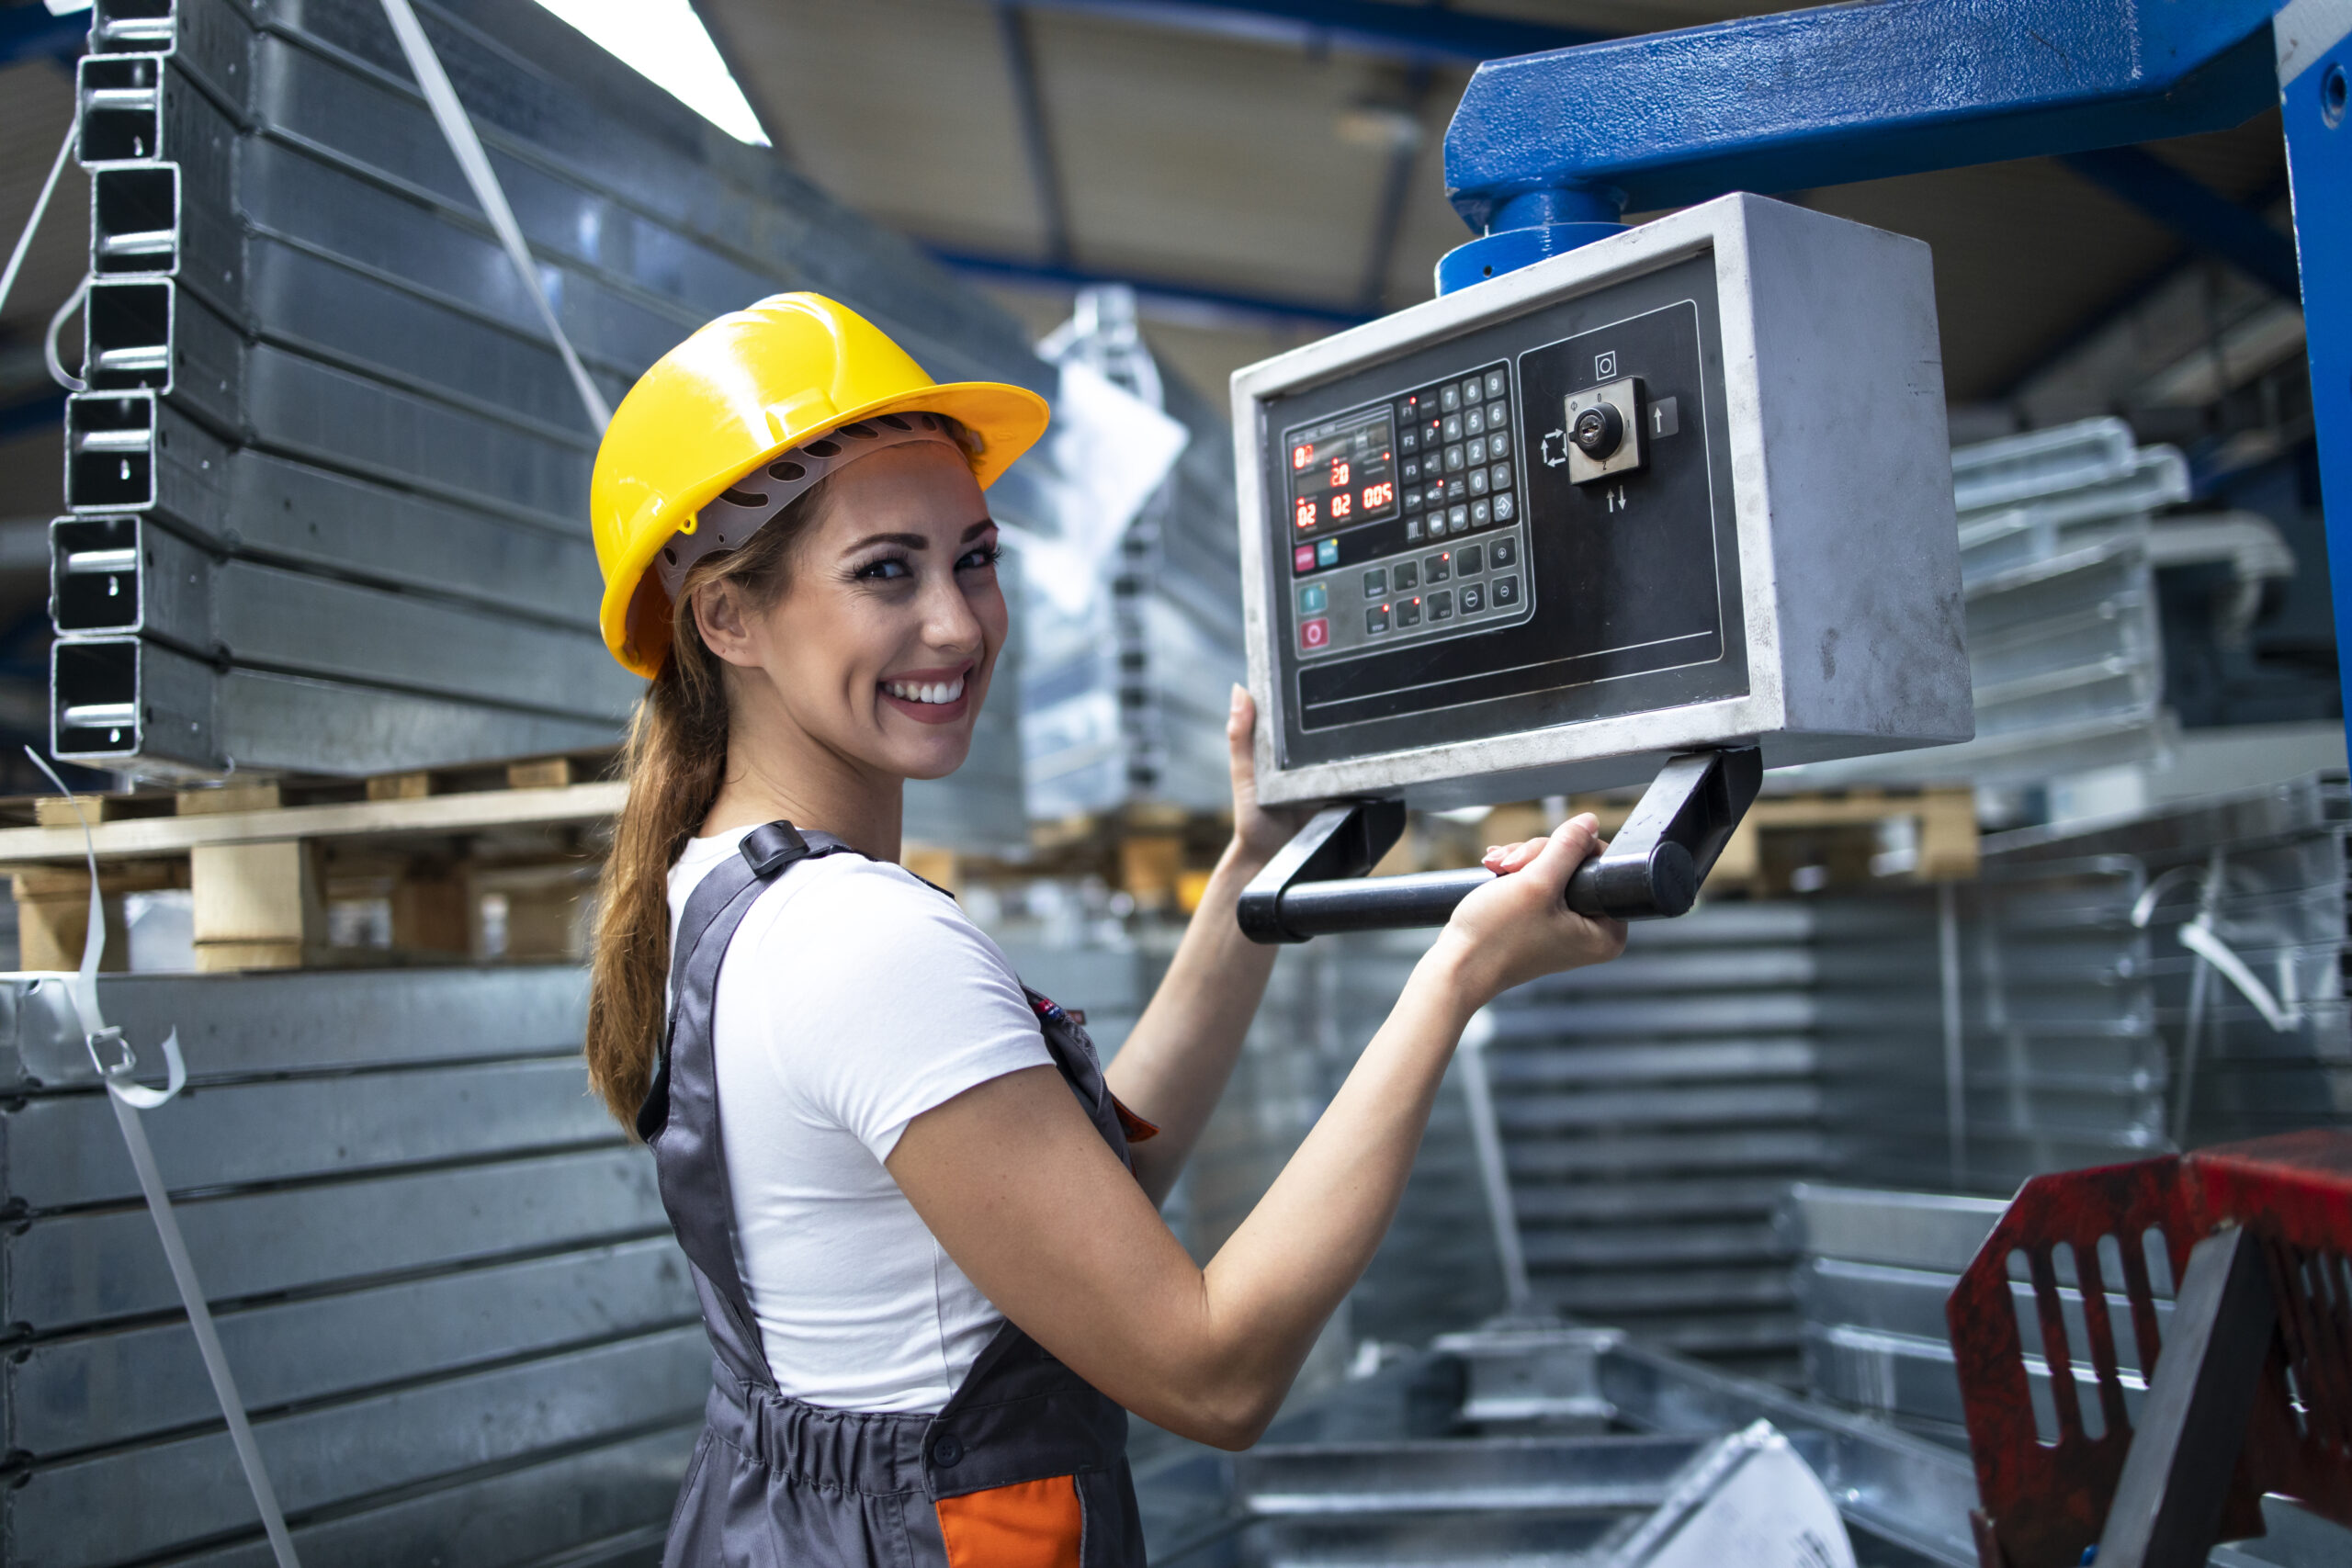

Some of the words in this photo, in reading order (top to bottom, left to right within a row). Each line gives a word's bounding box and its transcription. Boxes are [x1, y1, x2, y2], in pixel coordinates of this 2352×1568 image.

[1490, 378, 1498, 390] 9
[1446, 391, 1453, 404] 7
[1467, 385, 1476, 398] 8
[1403, 406, 1412, 417] F1
[1492, 408, 1500, 422] 6
[1471, 414, 1478, 427] 5
[1426, 428, 1434, 441] P
[1448, 422, 1456, 434] 4
[1404, 435, 1415, 446] F2
[1495, 439, 1502, 452] 3
[1452, 451, 1457, 464] 1
[1472, 446, 1480, 458] 2
[1406, 464, 1417, 476] F3
[1475, 475, 1482, 489] 0
[1331, 493, 1351, 517] 02
[1296, 503, 1317, 527] 02
[1476, 505, 1486, 520] C
